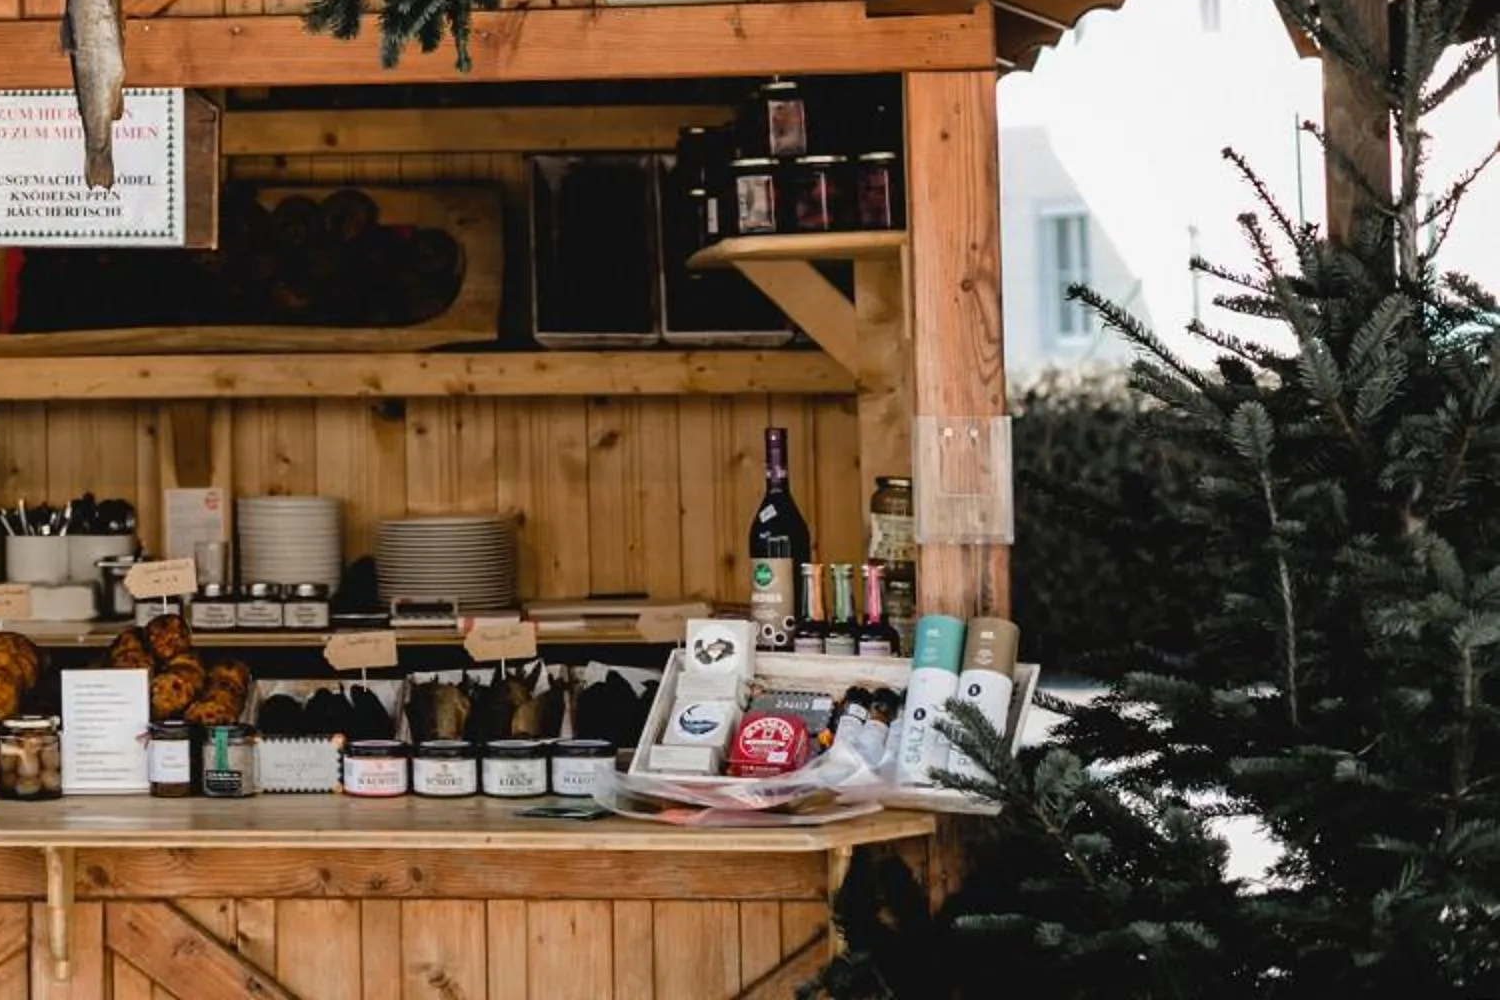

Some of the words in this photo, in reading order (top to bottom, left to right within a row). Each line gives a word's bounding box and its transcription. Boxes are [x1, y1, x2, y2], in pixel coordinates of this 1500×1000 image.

[11, 125, 49, 140] ZUM
[9, 188, 122, 201] KNÖDELSUPPEN
[6, 204, 125, 218] RÄUCHERFISCHE
